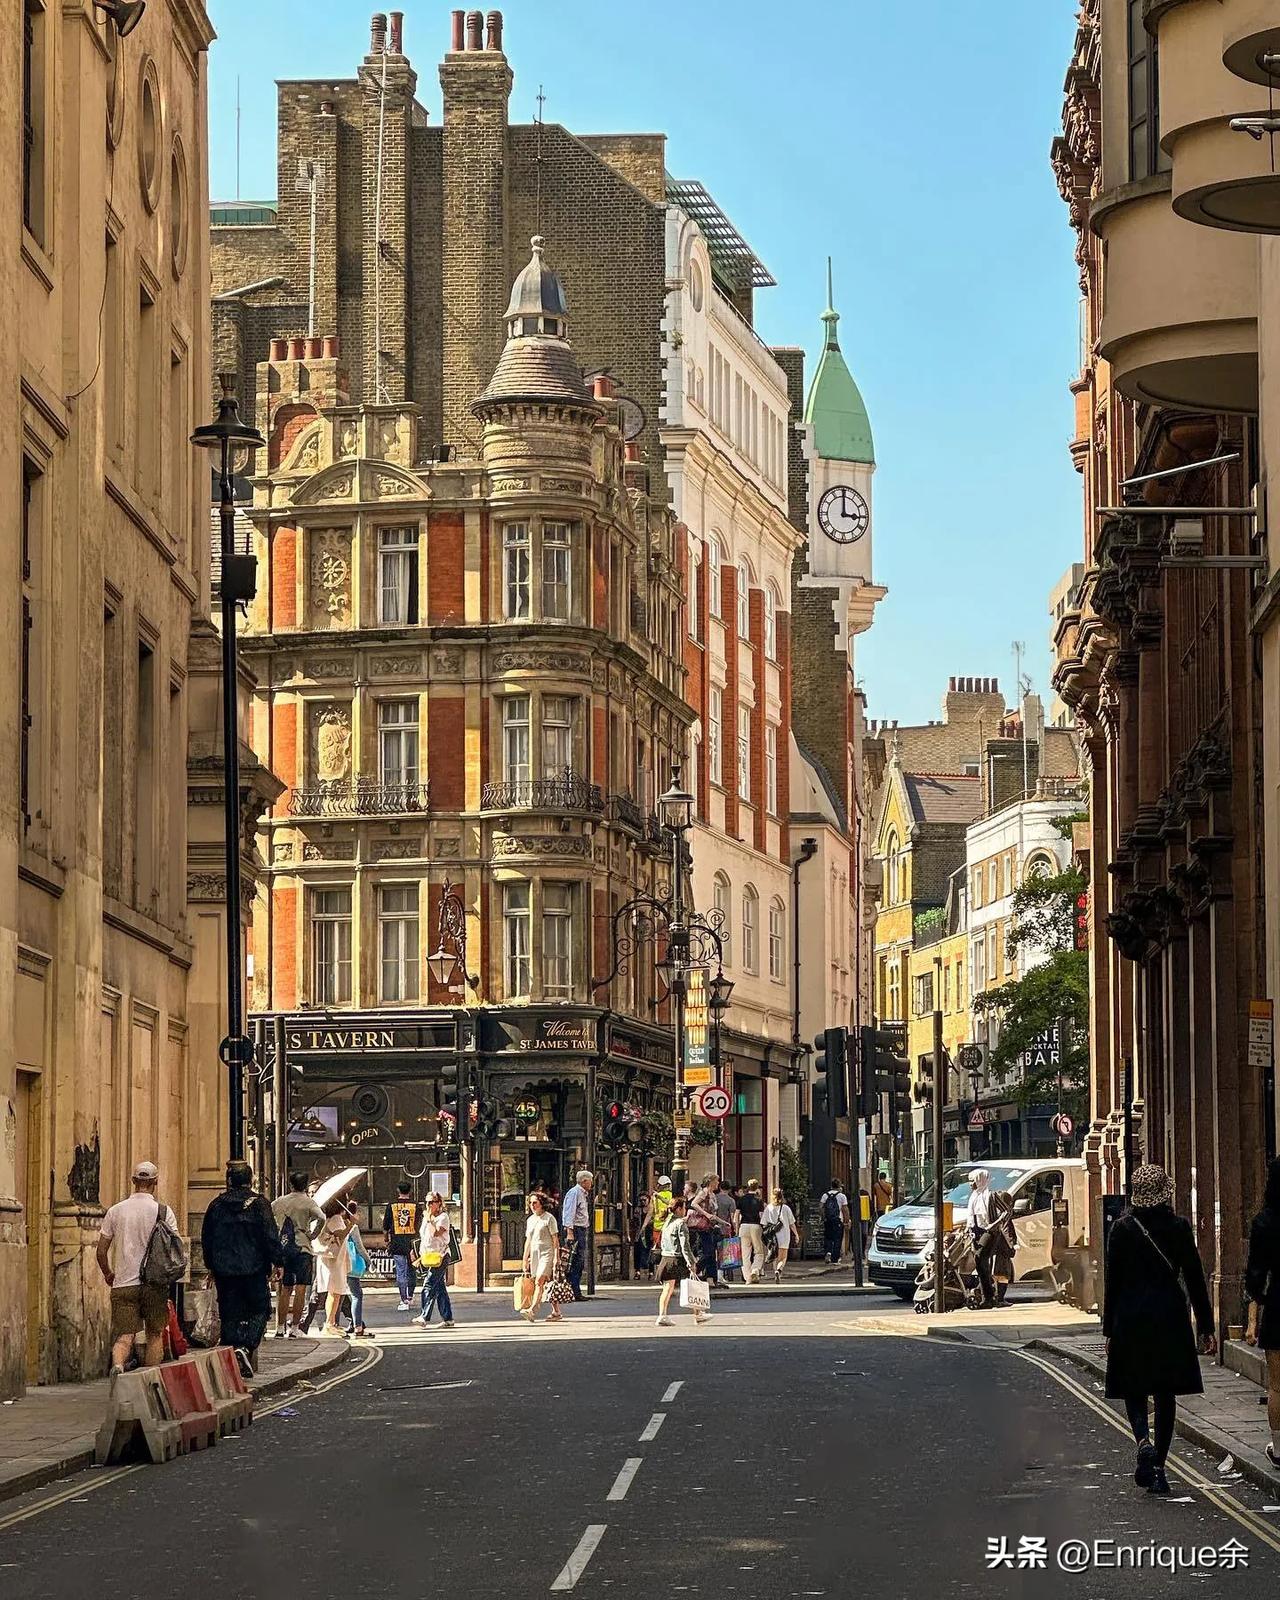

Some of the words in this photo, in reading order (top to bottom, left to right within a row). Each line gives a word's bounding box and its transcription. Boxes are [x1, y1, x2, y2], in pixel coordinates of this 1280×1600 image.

[542, 1020, 581, 1037] Welcome
[1028, 1028, 1060, 1042] NE
[307, 1030, 395, 1049] TAVERN
[534, 1039, 569, 1049] JAMES
[1025, 1050, 1060, 1066] BAR
[515, 1101, 537, 1118] 45
[704, 1096, 728, 1110] 20
[351, 1127, 379, 1146] OPEN
